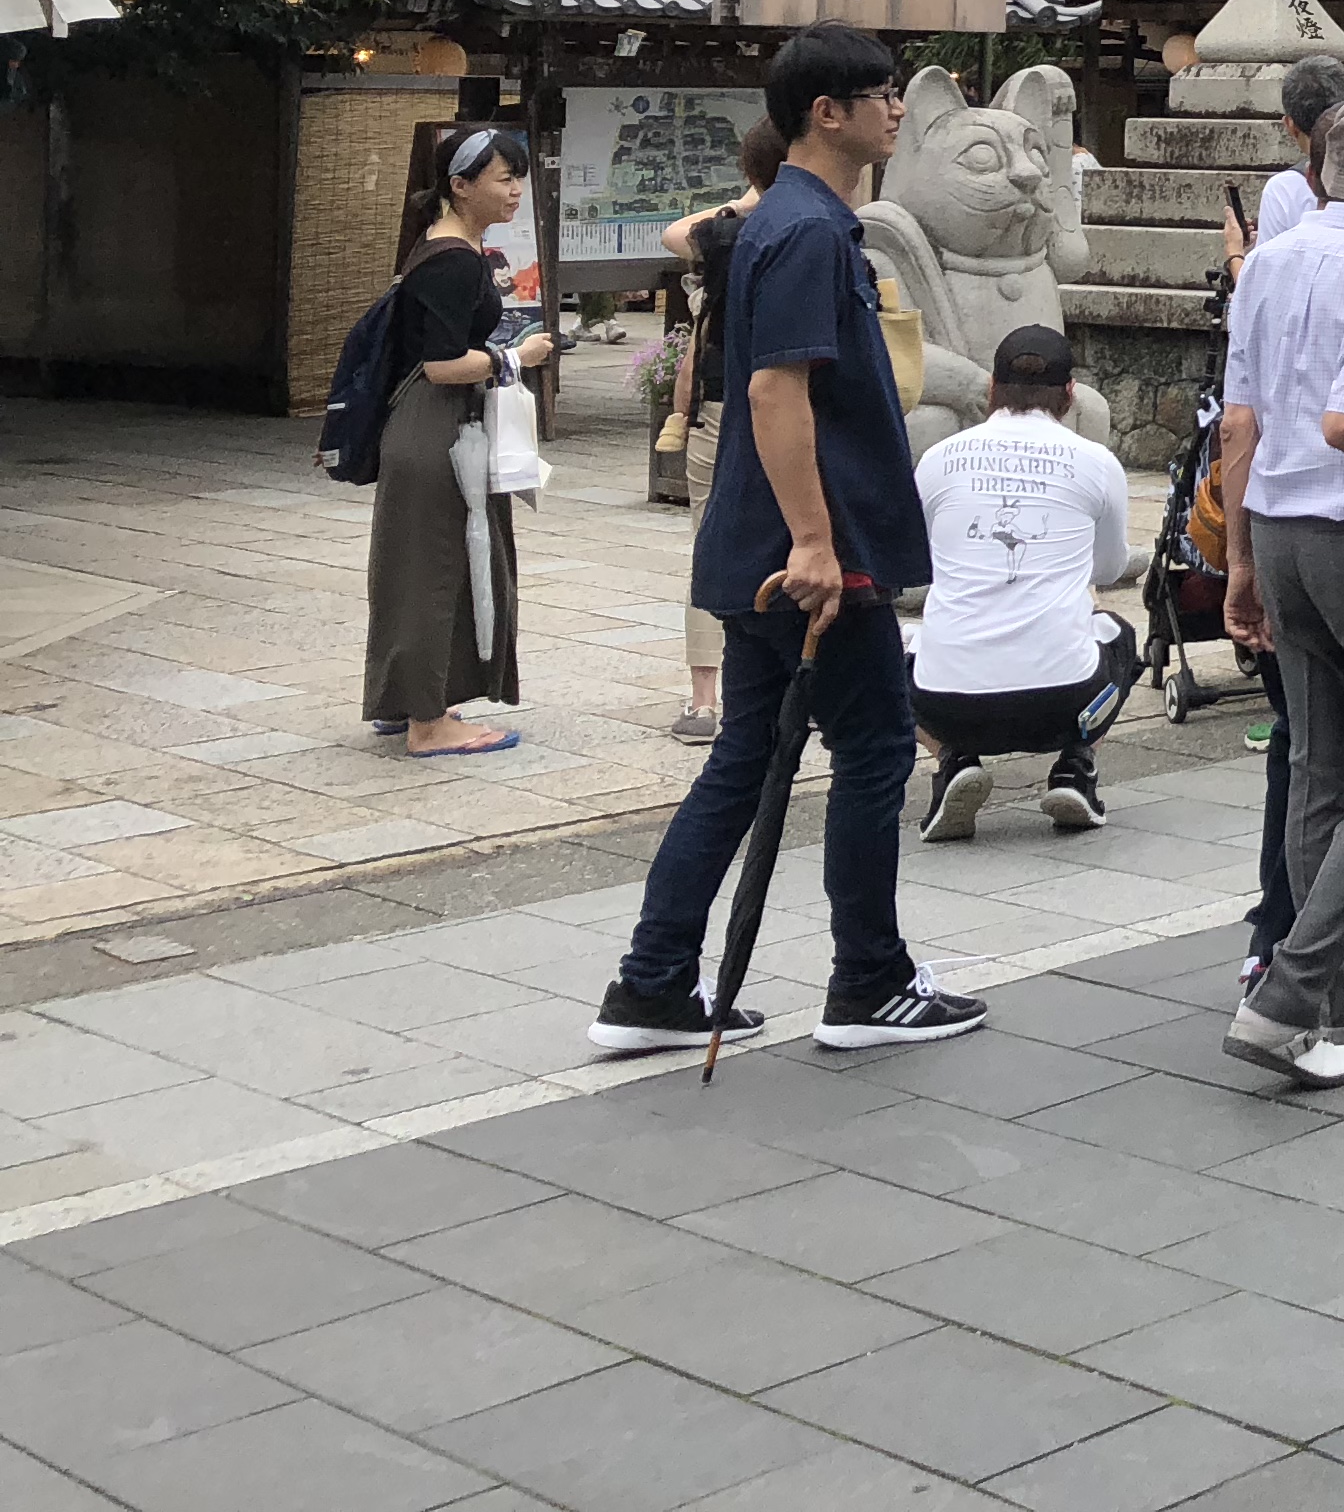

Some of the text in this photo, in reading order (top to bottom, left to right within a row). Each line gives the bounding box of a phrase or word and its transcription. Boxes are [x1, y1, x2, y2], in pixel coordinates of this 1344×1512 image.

[943, 438, 1078, 460] ROCKSTEADY
[942, 456, 1076, 479] DRUNKARD'S
[971, 477, 1047, 495] DREAM
